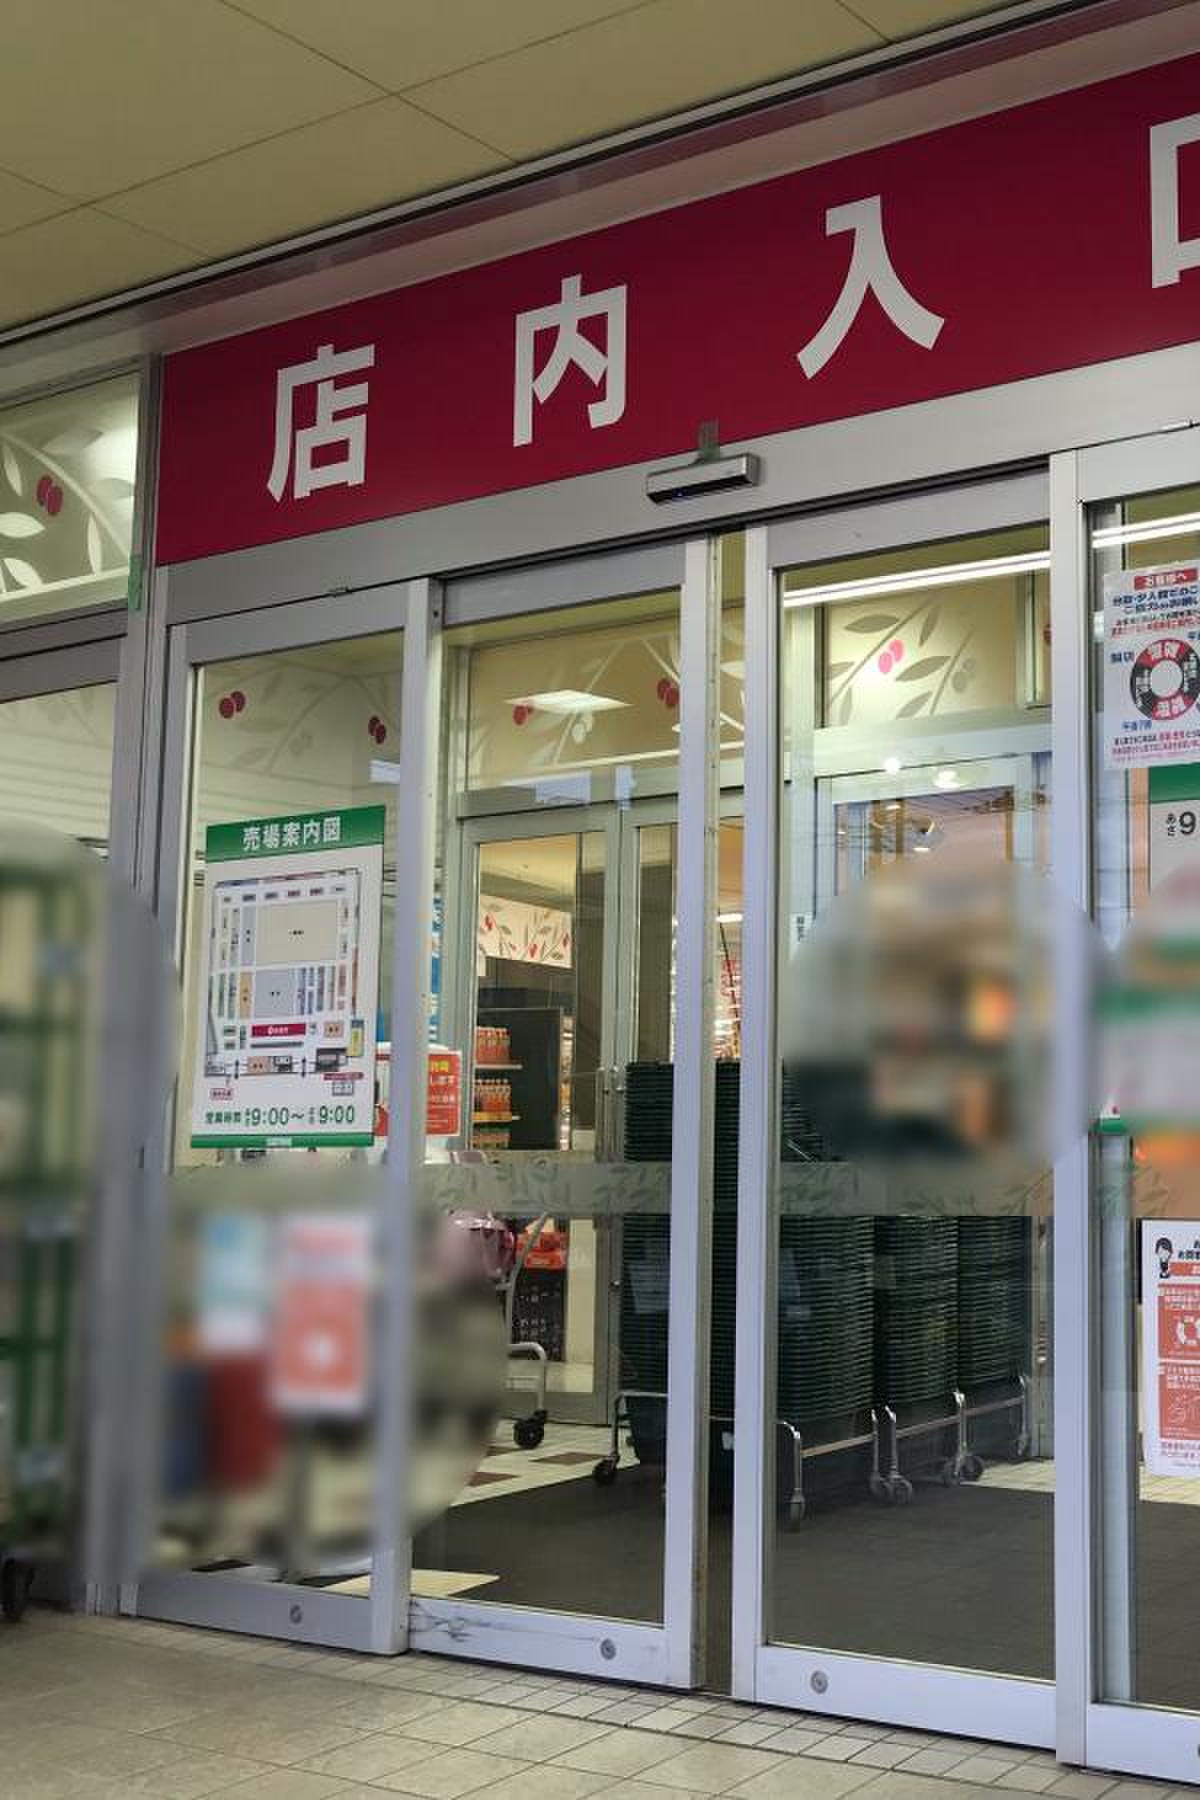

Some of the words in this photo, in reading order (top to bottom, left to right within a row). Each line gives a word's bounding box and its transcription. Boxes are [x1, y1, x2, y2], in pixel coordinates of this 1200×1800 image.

[242, 816, 342, 851] 売場案内図
